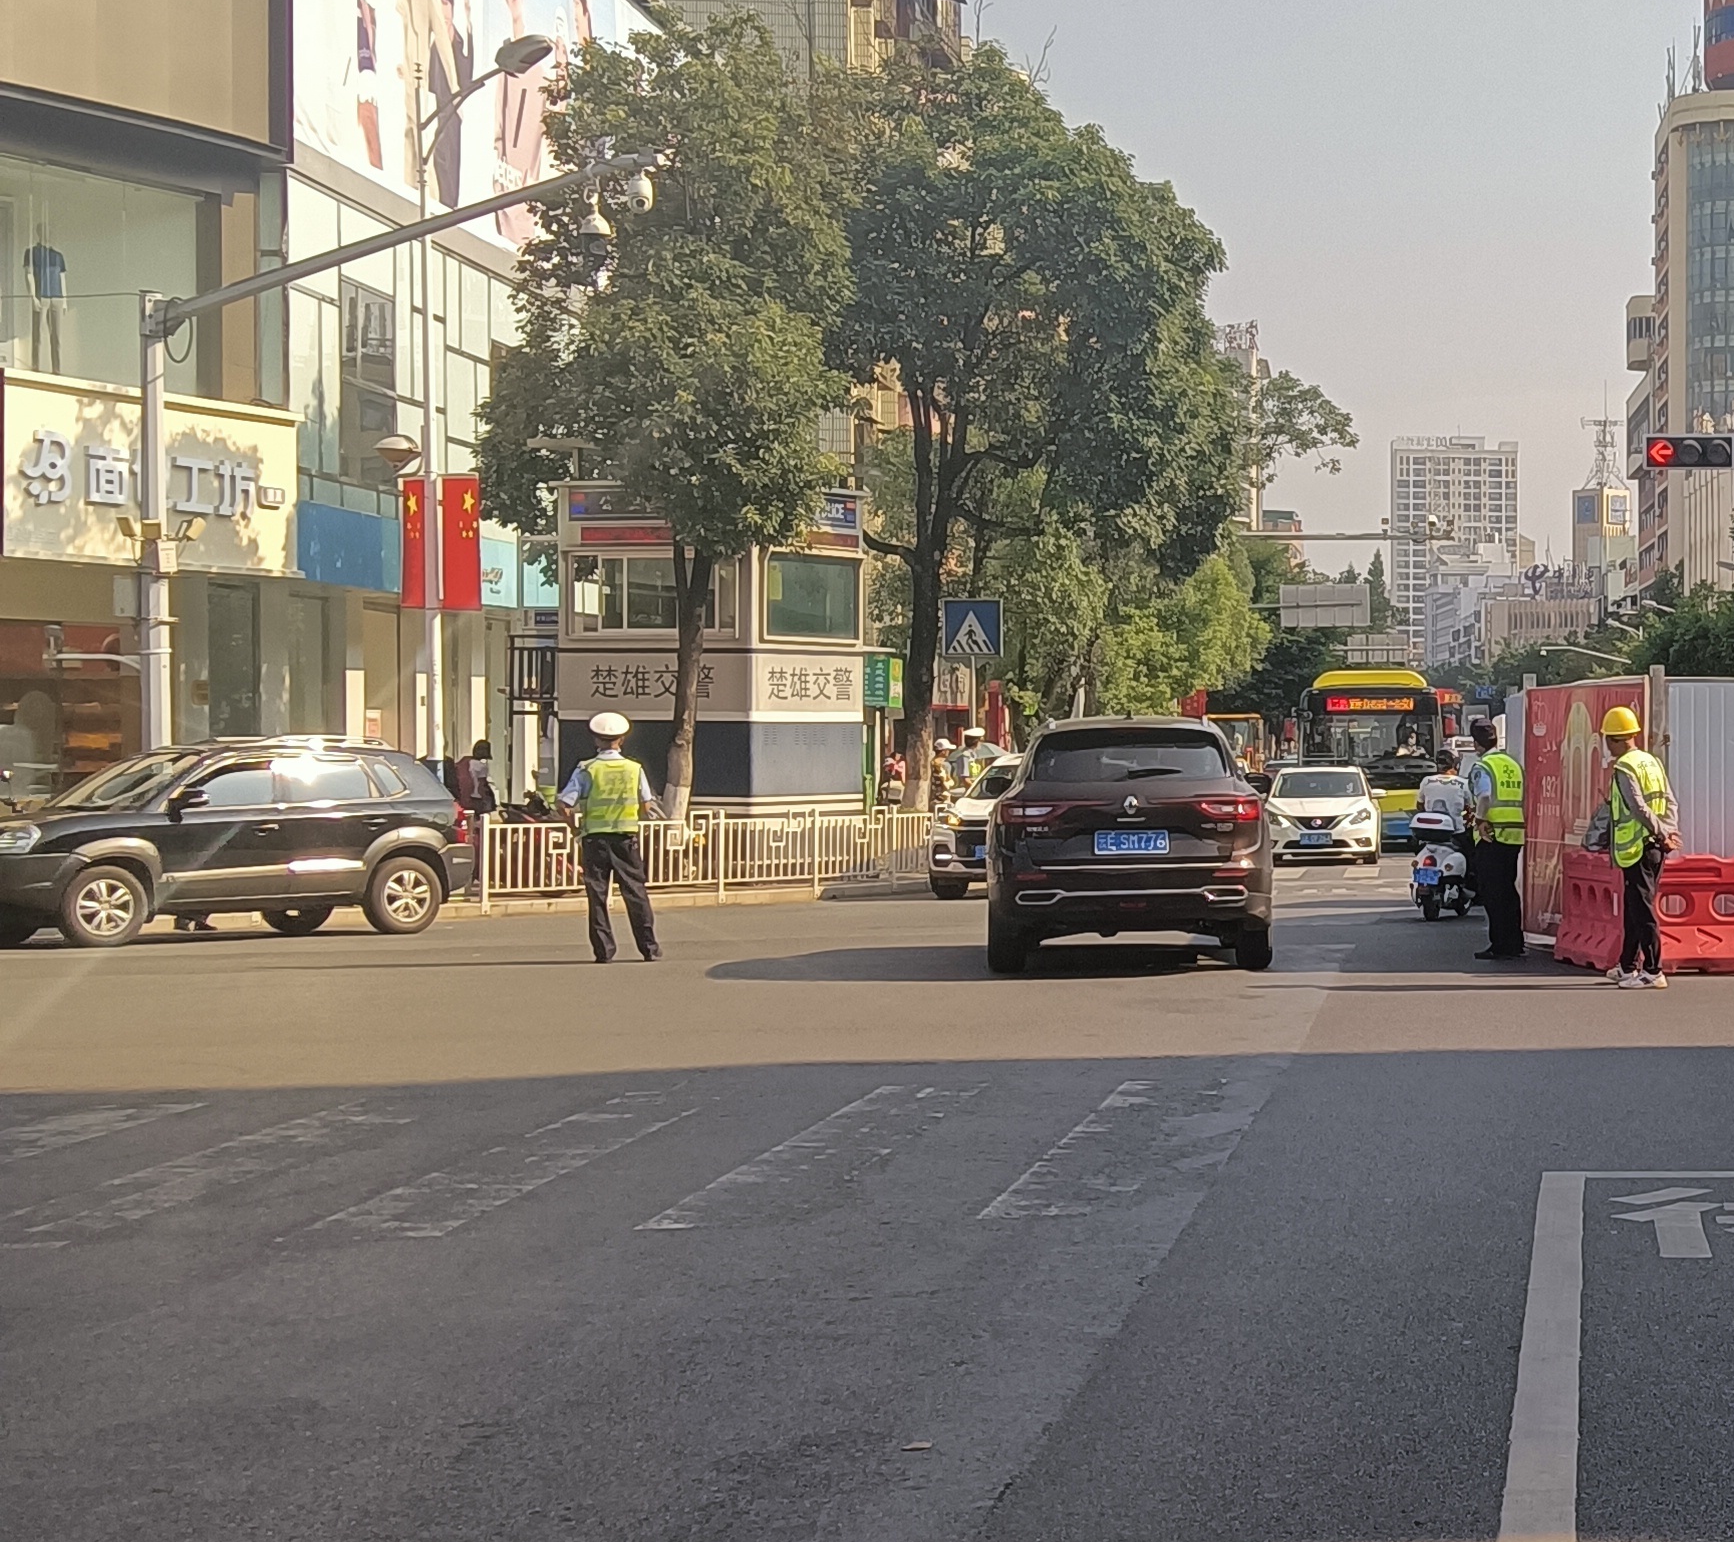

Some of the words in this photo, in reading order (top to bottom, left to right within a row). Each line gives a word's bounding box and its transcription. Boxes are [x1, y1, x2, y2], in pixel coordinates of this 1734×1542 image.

[84, 445, 255, 516] 面工坊
[591, 664, 714, 699] 楚雄交警
[767, 666, 853, 702] 楚雄交警
